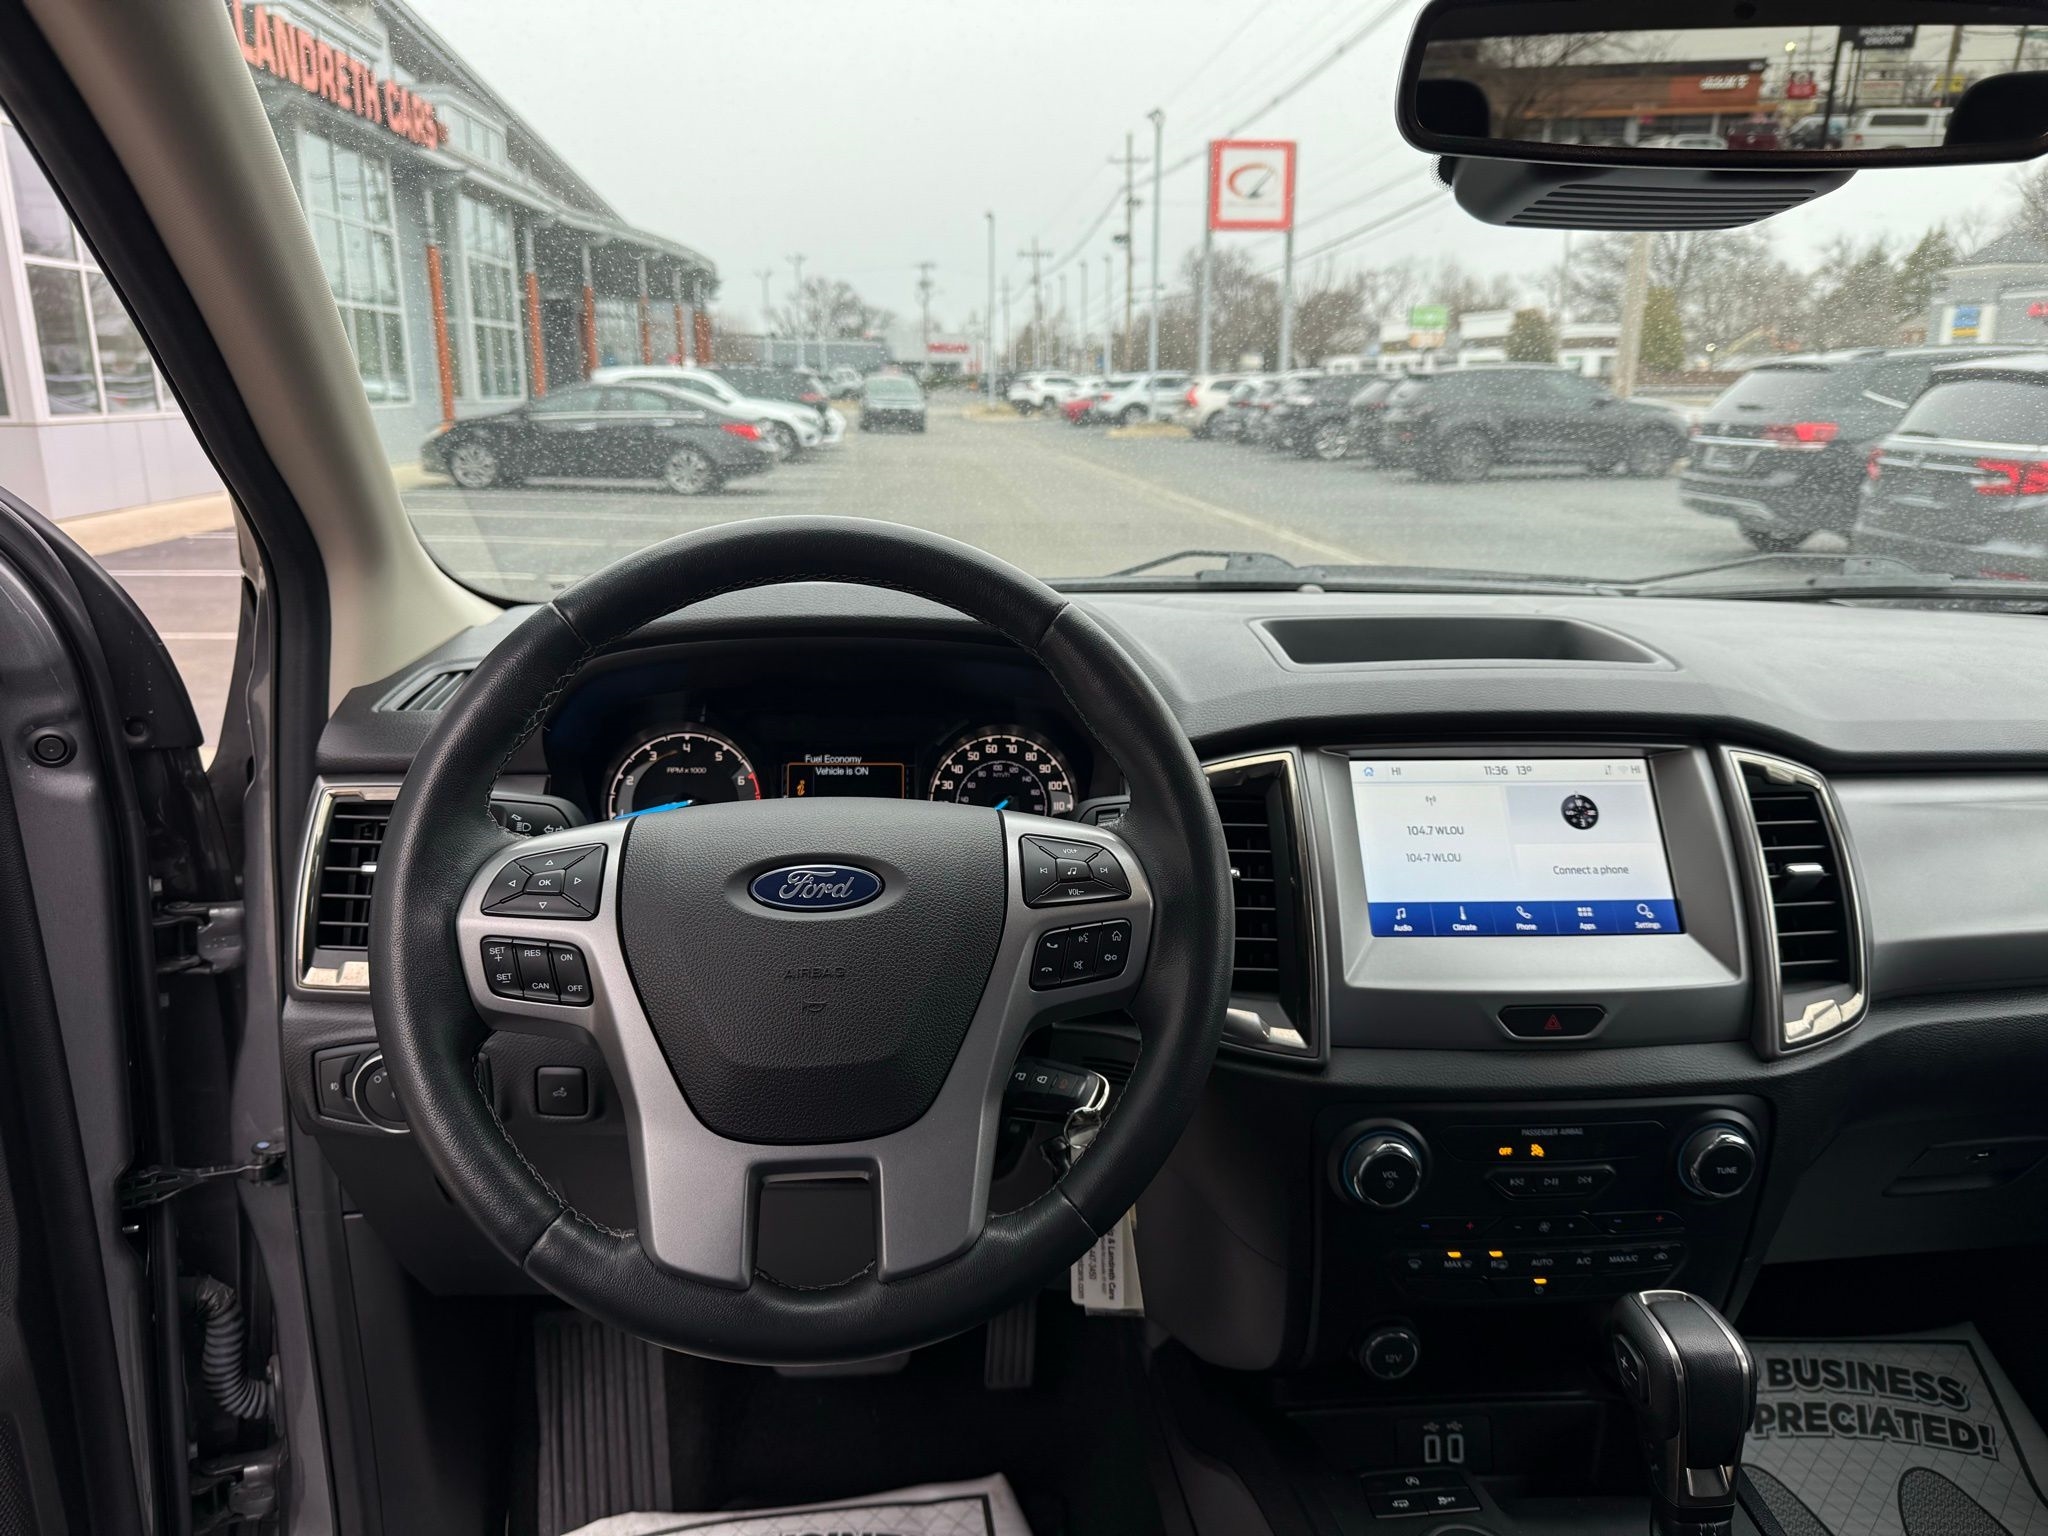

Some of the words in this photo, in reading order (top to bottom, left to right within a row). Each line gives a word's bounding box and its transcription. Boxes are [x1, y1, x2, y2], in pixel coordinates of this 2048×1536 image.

[231, 0, 382, 125] LANDRETH
[384, 78, 440, 151] CARS
[682, 743, 691, 753] 4
[985, 744, 998, 754] 60
[1005, 744, 1018, 754] 70
[650, 752, 658, 761] 3
[714, 752, 723, 761] 5
[804, 753, 823, 764] Fuel
[824, 754, 862, 764] Economy
[967, 751, 980, 761] 50
[1025, 752, 1038, 762] 80
[815, 766, 845, 776] Vehicle
[846, 766, 853, 776] is
[854, 766, 869, 776] ON
[951, 764, 964, 774] 40
[1039, 764, 1051, 774] 90
[1391, 766, 1402, 776] HI
[1484, 765, 1509, 776] 11:36
[1630, 765, 1641, 775] HI
[626, 775, 634, 786] 2
[737, 775, 746, 786] 6
[941, 781, 954, 790] 30
[1048, 781, 1062, 790] 100
[1053, 801, 1065, 811] 110
[1407, 825, 1433, 836] 104.7
[1435, 825, 1464, 836] WLOU
[1406, 852, 1431, 863] 104-7
[1432, 852, 1462, 863] WLOU
[1553, 865, 1591, 876] Connect
[1600, 865, 1629, 877] phone
[538, 879, 552, 887] OK
[778, 870, 855, 900] Ford
[1394, 923, 1413, 932] Audio
[1452, 923, 1478, 932] Climate
[1516, 923, 1537, 931] Phone
[1579, 922, 1597, 931] Apps
[1635, 921, 1662, 930] Settings
[489, 946, 505, 955] SET
[524, 949, 541, 957] RES
[560, 953, 573, 961] ON
[496, 972, 512, 981] SET
[783, 967, 847, 981] AIRBAG
[567, 984, 583, 992] OFF
[1521, 1128, 1558, 1136] PASSENGER
[1559, 1127, 1584, 1136] AIRBAG
[1498, 1146, 1514, 1156] OFF
[1382, 1170, 1399, 1179] VOL
[1715, 1166, 1738, 1175] TUNE
[1443, 1260, 1462, 1269] MAX
[1531, 1258, 1554, 1267] AUTO
[1576, 1256, 1592, 1266] A/C
[1384, 1353, 1402, 1364] 12V
[1766, 1358, 1968, 1409] BUSINESS
[1753, 1401, 1996, 1459] PRECIATED!
